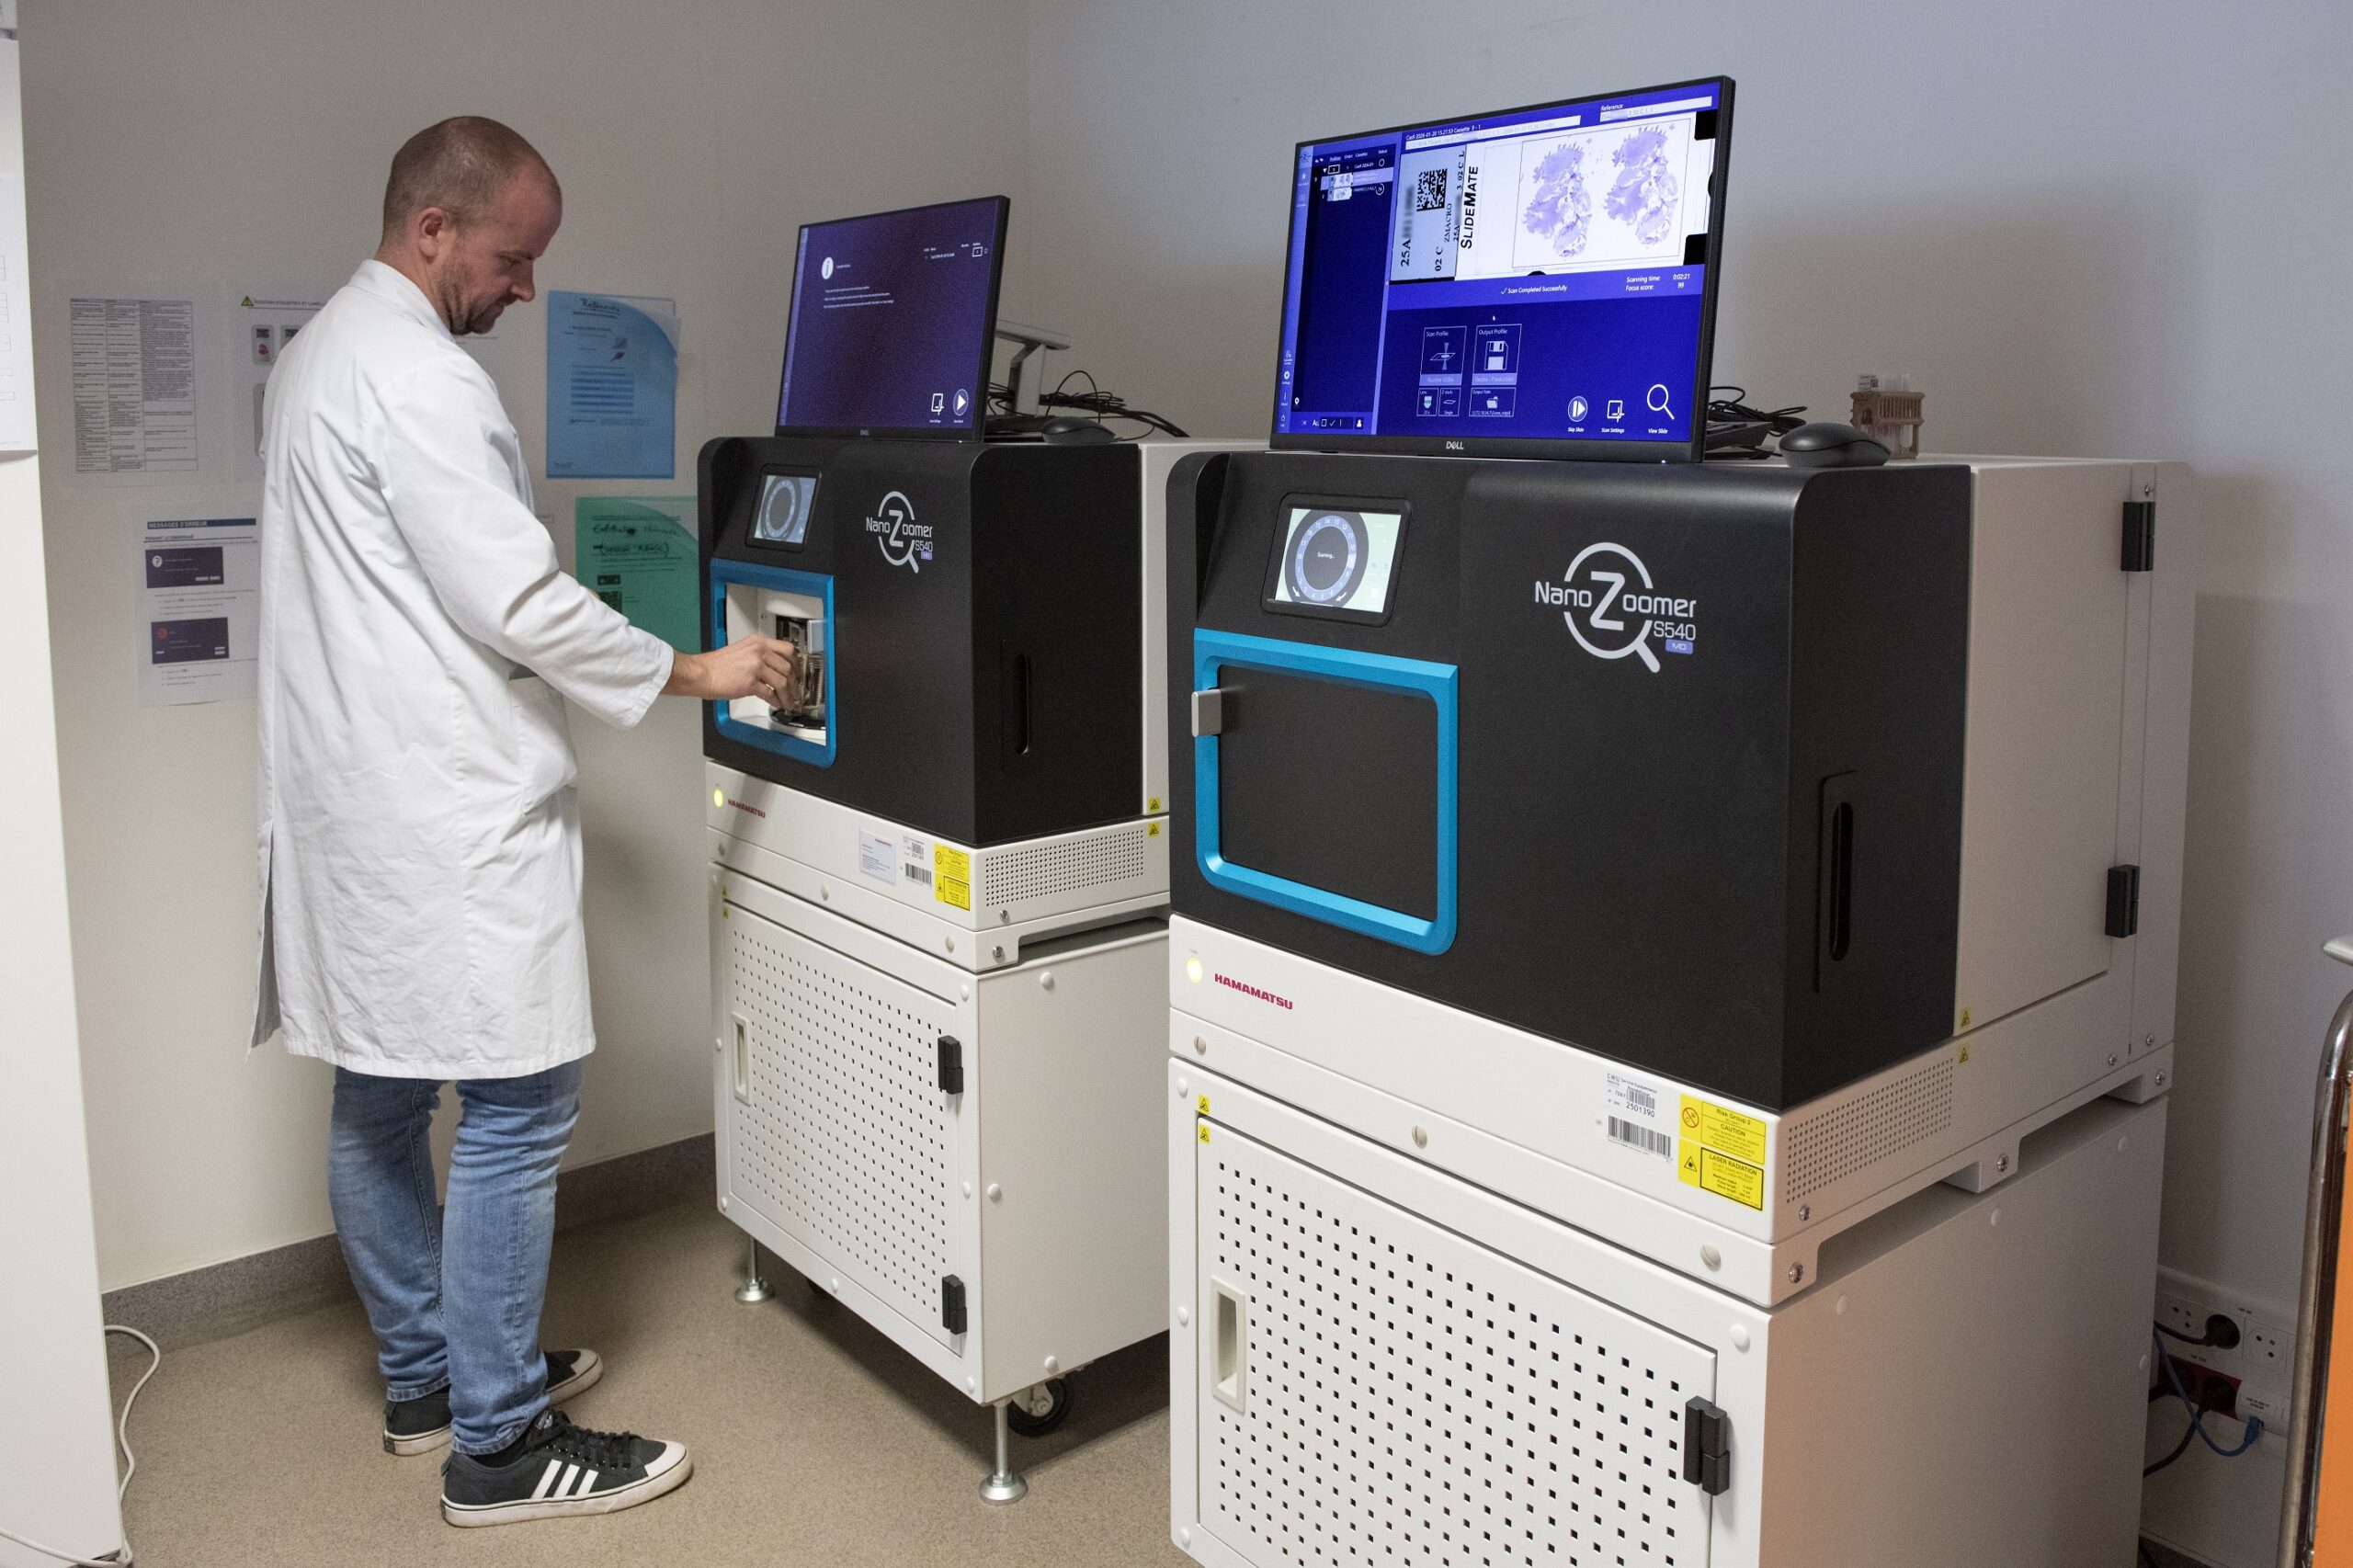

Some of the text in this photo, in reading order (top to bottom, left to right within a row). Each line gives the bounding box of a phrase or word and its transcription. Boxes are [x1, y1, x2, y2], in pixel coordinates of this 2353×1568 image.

[1435, 246, 1443, 271] 02 C
[1518, 286, 1540, 294] Completed
[1542, 284, 1567, 292] Successfully
[1446, 441, 1464, 449] DELL
[866, 509, 933, 547] NanoZoomer
[915, 540, 933, 552] S540
[1535, 571, 1697, 631] NanoZoomer
[1654, 620, 1696, 641] S540
[1672, 642, 1687, 651] MD
[1214, 972, 1293, 1010] HAMAMATSU
[1607, 1074, 1620, 1082] CHU
[1626, 1102, 1655, 1118] 2501390
[1729, 1113, 1746, 1124] Group
[1720, 1123, 1745, 1137] CAUTION
[1710, 1153, 1757, 1176] LASER RADIATION
